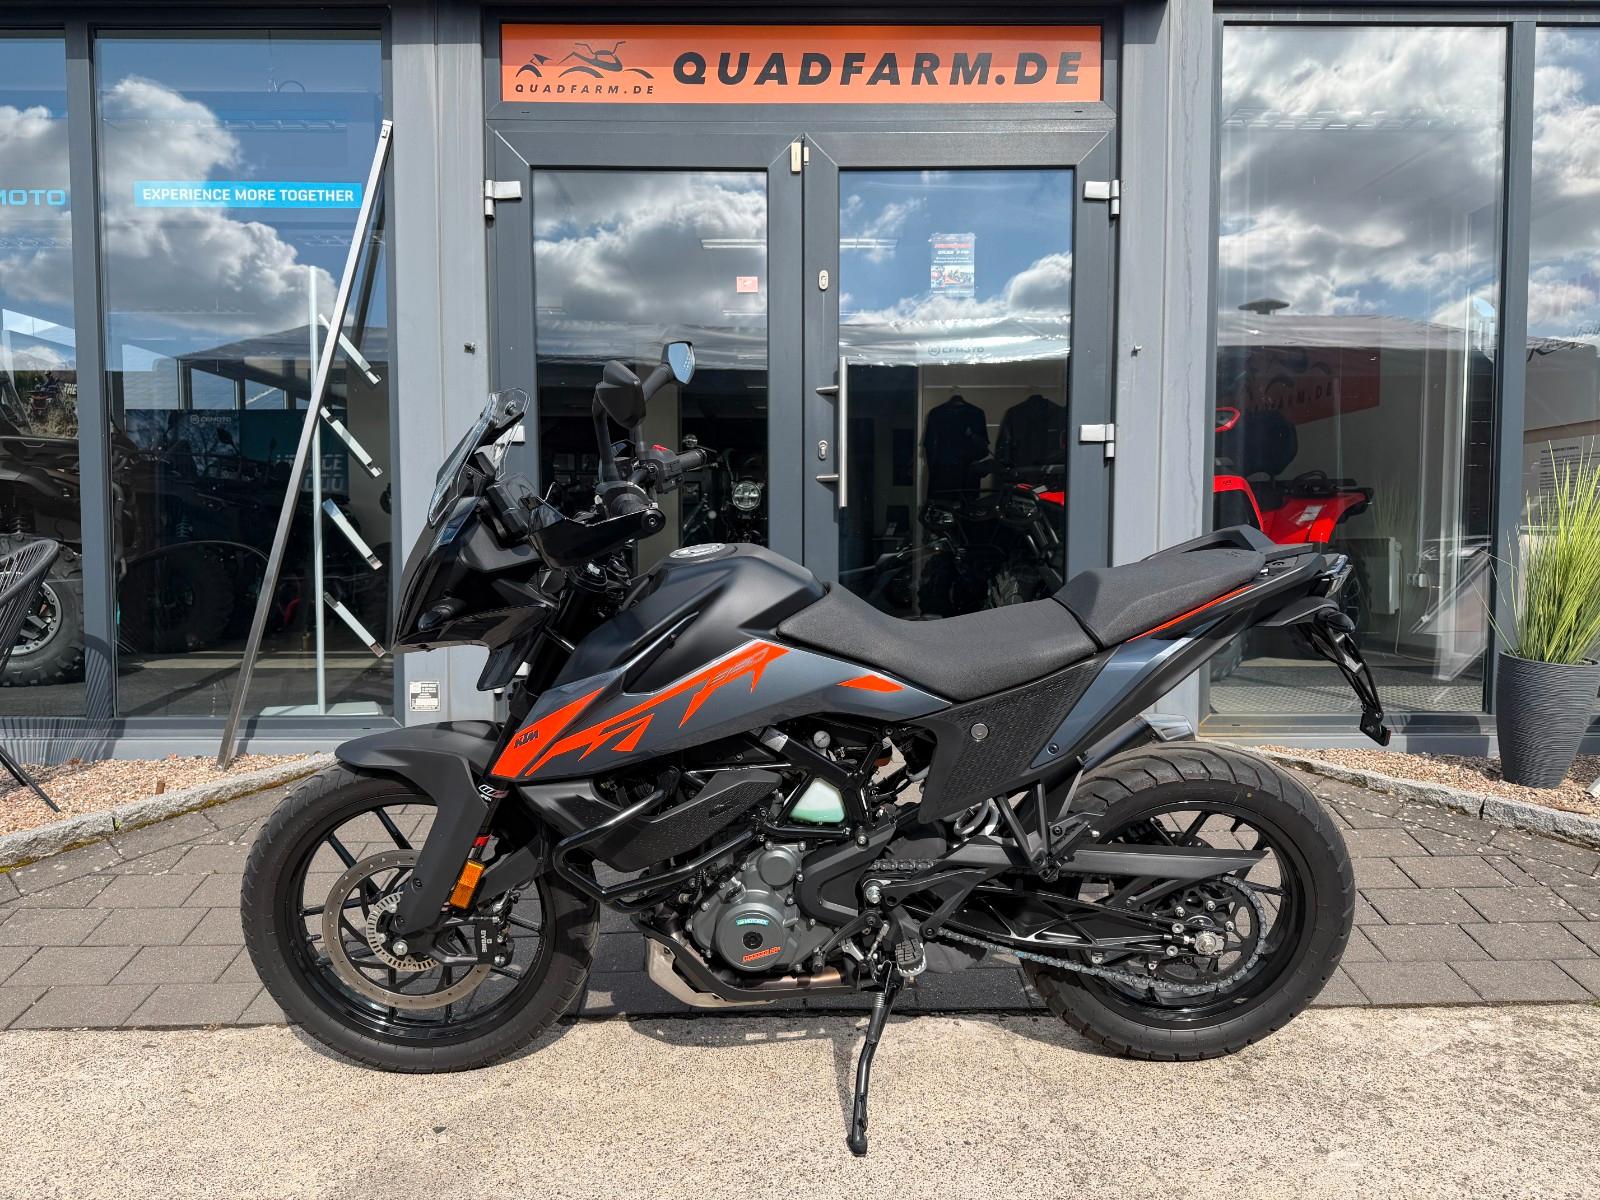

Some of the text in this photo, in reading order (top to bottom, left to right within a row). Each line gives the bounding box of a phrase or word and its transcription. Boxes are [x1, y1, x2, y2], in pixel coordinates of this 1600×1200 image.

[672, 51, 1082, 86] QUADFARM.DE
[515, 84, 654, 95] QUADFARM.DE
[142, 188, 355, 203] EXPERIENCE MORE TOGETHER
[514, 729, 539, 749] KTM
